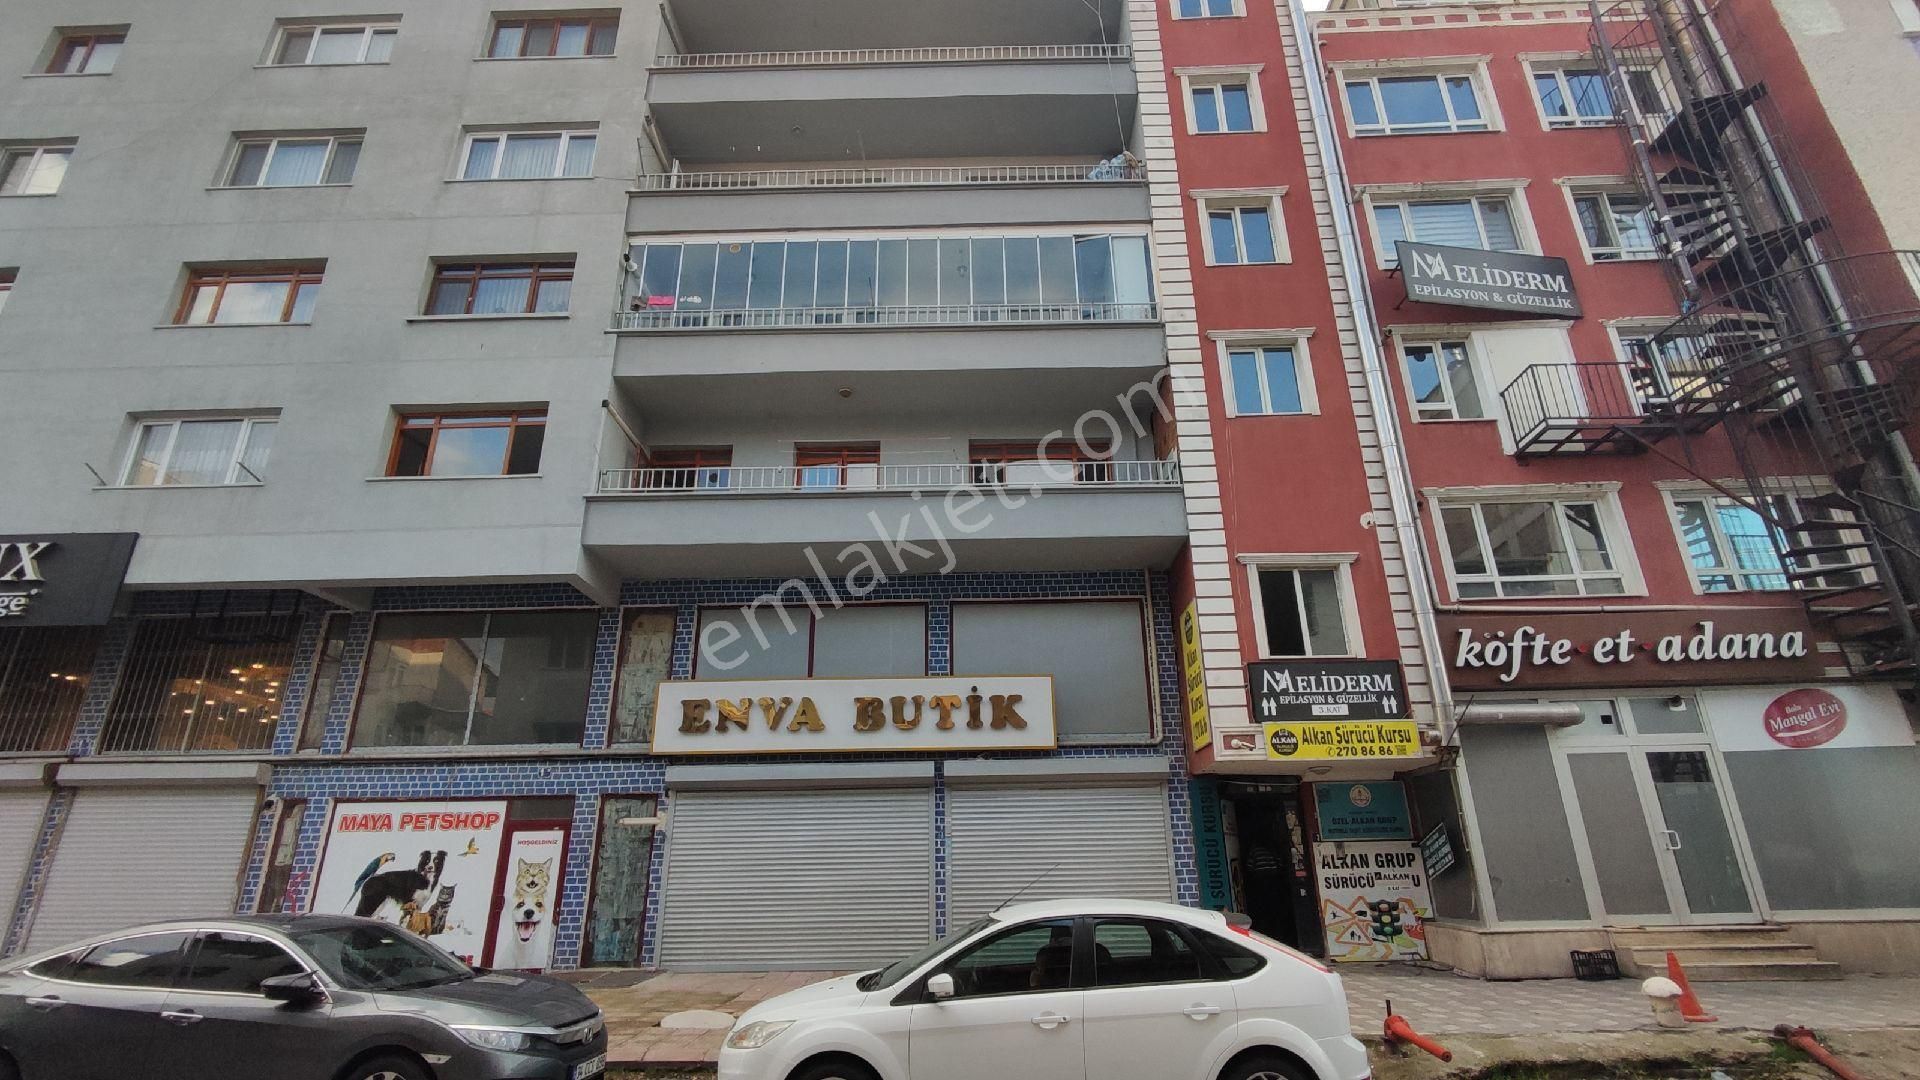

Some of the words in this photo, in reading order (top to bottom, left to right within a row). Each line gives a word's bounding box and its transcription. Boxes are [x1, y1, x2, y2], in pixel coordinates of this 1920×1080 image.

[1411, 249, 1569, 293] MELİDERM
[1414, 284, 1488, 302] EPİLASYON
[1493, 292, 1504, 304] &
[1507, 292, 1574, 310] GÜZELLİK
[1456, 626, 1572, 682] köfte
[1593, 629, 1636, 664] et
[1656, 621, 1808, 662] adana
[1261, 668, 1395, 694] MELİDERM
[678, 696, 826, 733] ENVA
[853, 685, 1028, 732] BUTİK
[1279, 693, 1326, 705] EPİLASYON
[1327, 694, 1335, 704] &
[1336, 691, 1378, 704] GÜZELLİK
[1769, 706, 1818, 732] Mangal
[1817, 700, 1841, 717] Evi
[1301, 726, 1334, 746] Alkan
[1335, 724, 1375, 745] Sürücü
[1376, 724, 1412, 744] Kursu
[1336, 746, 1359, 757] 270
[1361, 746, 1377, 756] 86
[1378, 745, 1394, 756] 86
[337, 813, 393, 833] MAYA
[397, 811, 501, 833] PETSHOP
[1321, 852, 1371, 870] ALKAN
[1374, 852, 1416, 869] GRUP
[1324, 872, 1376, 890] SÜRÜCÜ
